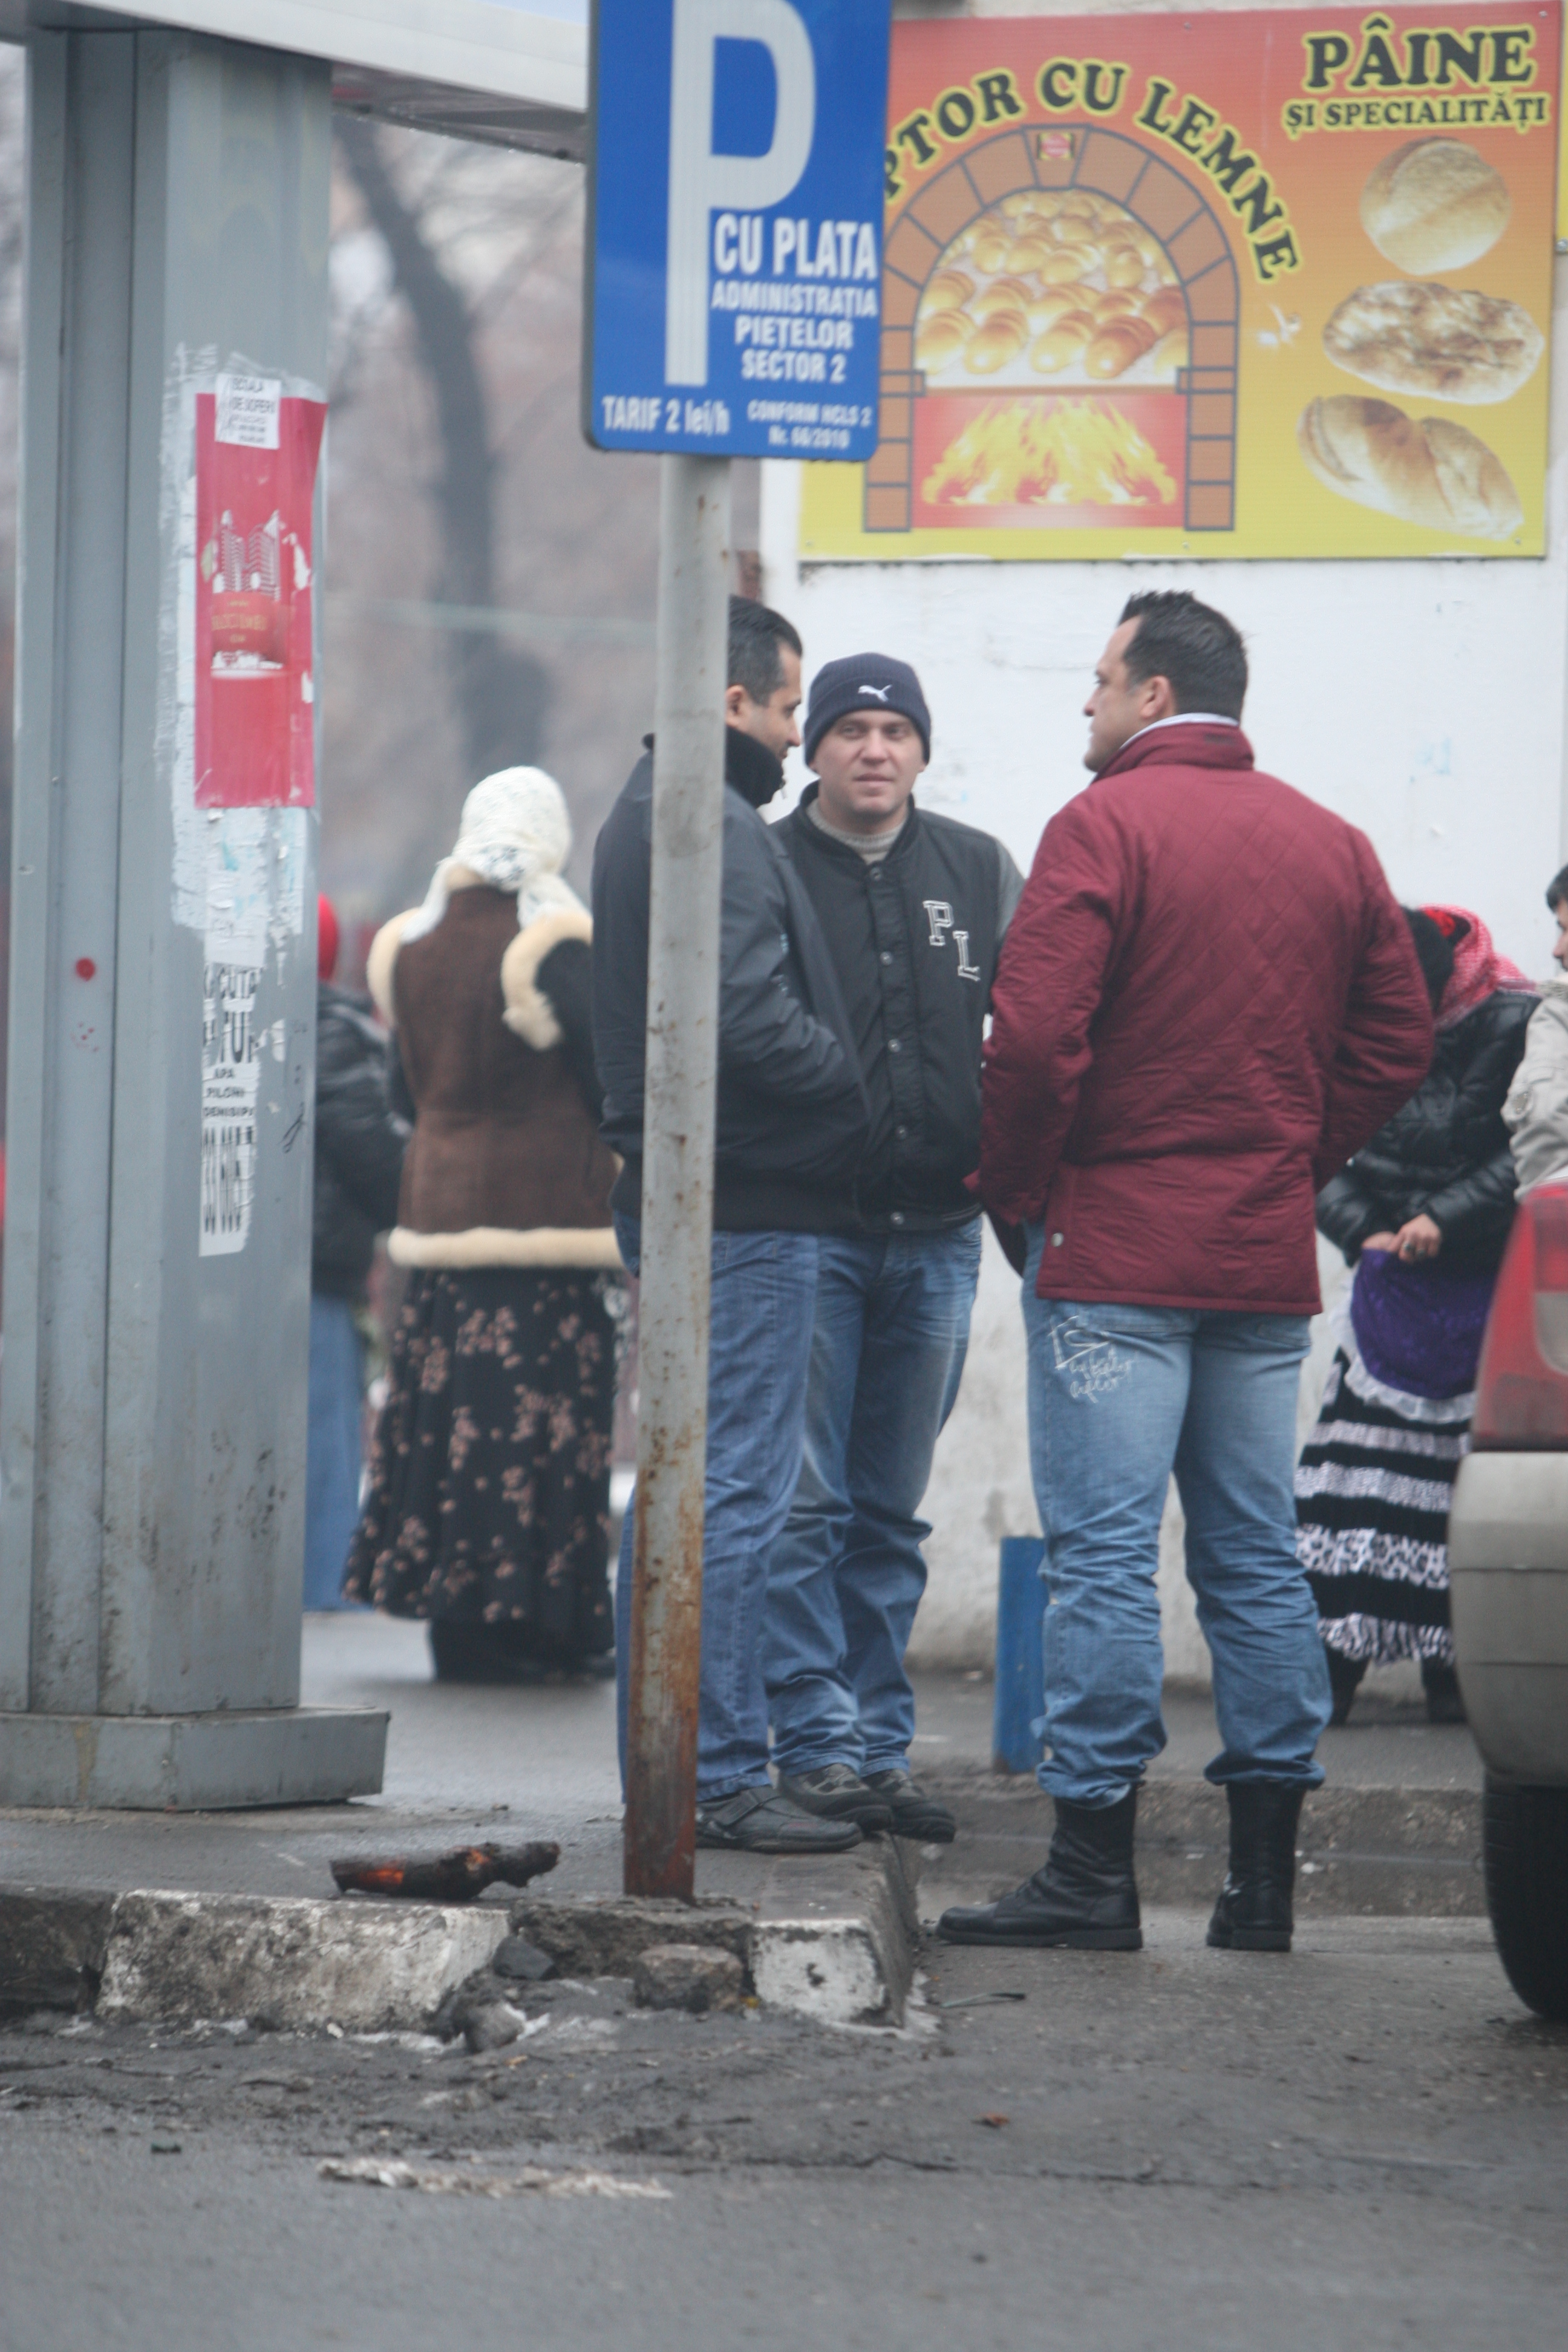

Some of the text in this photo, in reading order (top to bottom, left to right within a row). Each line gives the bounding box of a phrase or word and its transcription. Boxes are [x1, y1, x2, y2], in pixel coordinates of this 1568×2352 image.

[1306, 18, 1532, 88] PÂINE
[1325, 92, 1546, 127] SPECIALITĂȚI
[665, 0, 816, 387] P
[1041, 62, 1125, 111] CU
[1139, 82, 1298, 279] LEMNE
[714, 213, 878, 280] CU PLATA
[741, 349, 847, 384] SECTOR 2
[602, 395, 662, 432] TARIF
[665, 397, 681, 433] 2
[860, 405, 872, 427] 2
